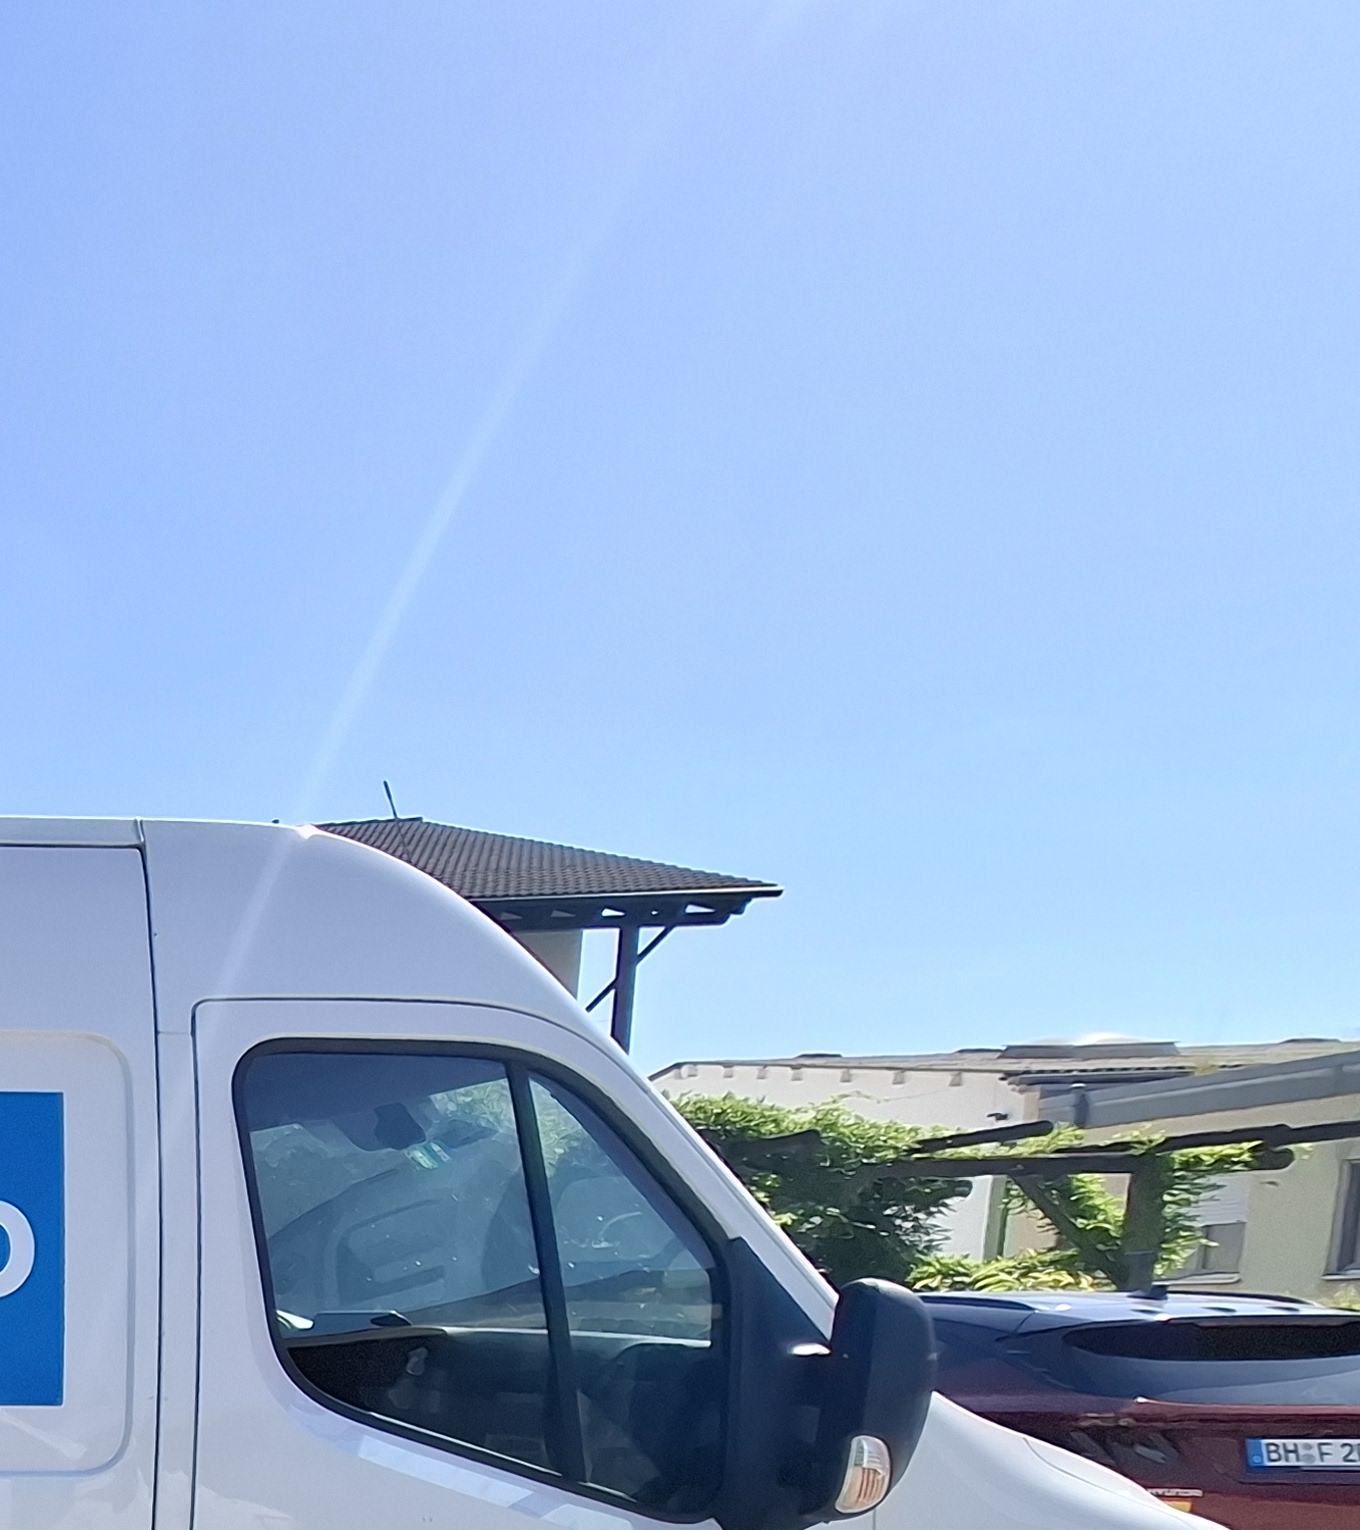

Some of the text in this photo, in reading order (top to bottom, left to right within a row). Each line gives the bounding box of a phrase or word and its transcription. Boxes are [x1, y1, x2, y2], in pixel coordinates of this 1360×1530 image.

[1265, 1442, 1360, 1463] BH F 2
